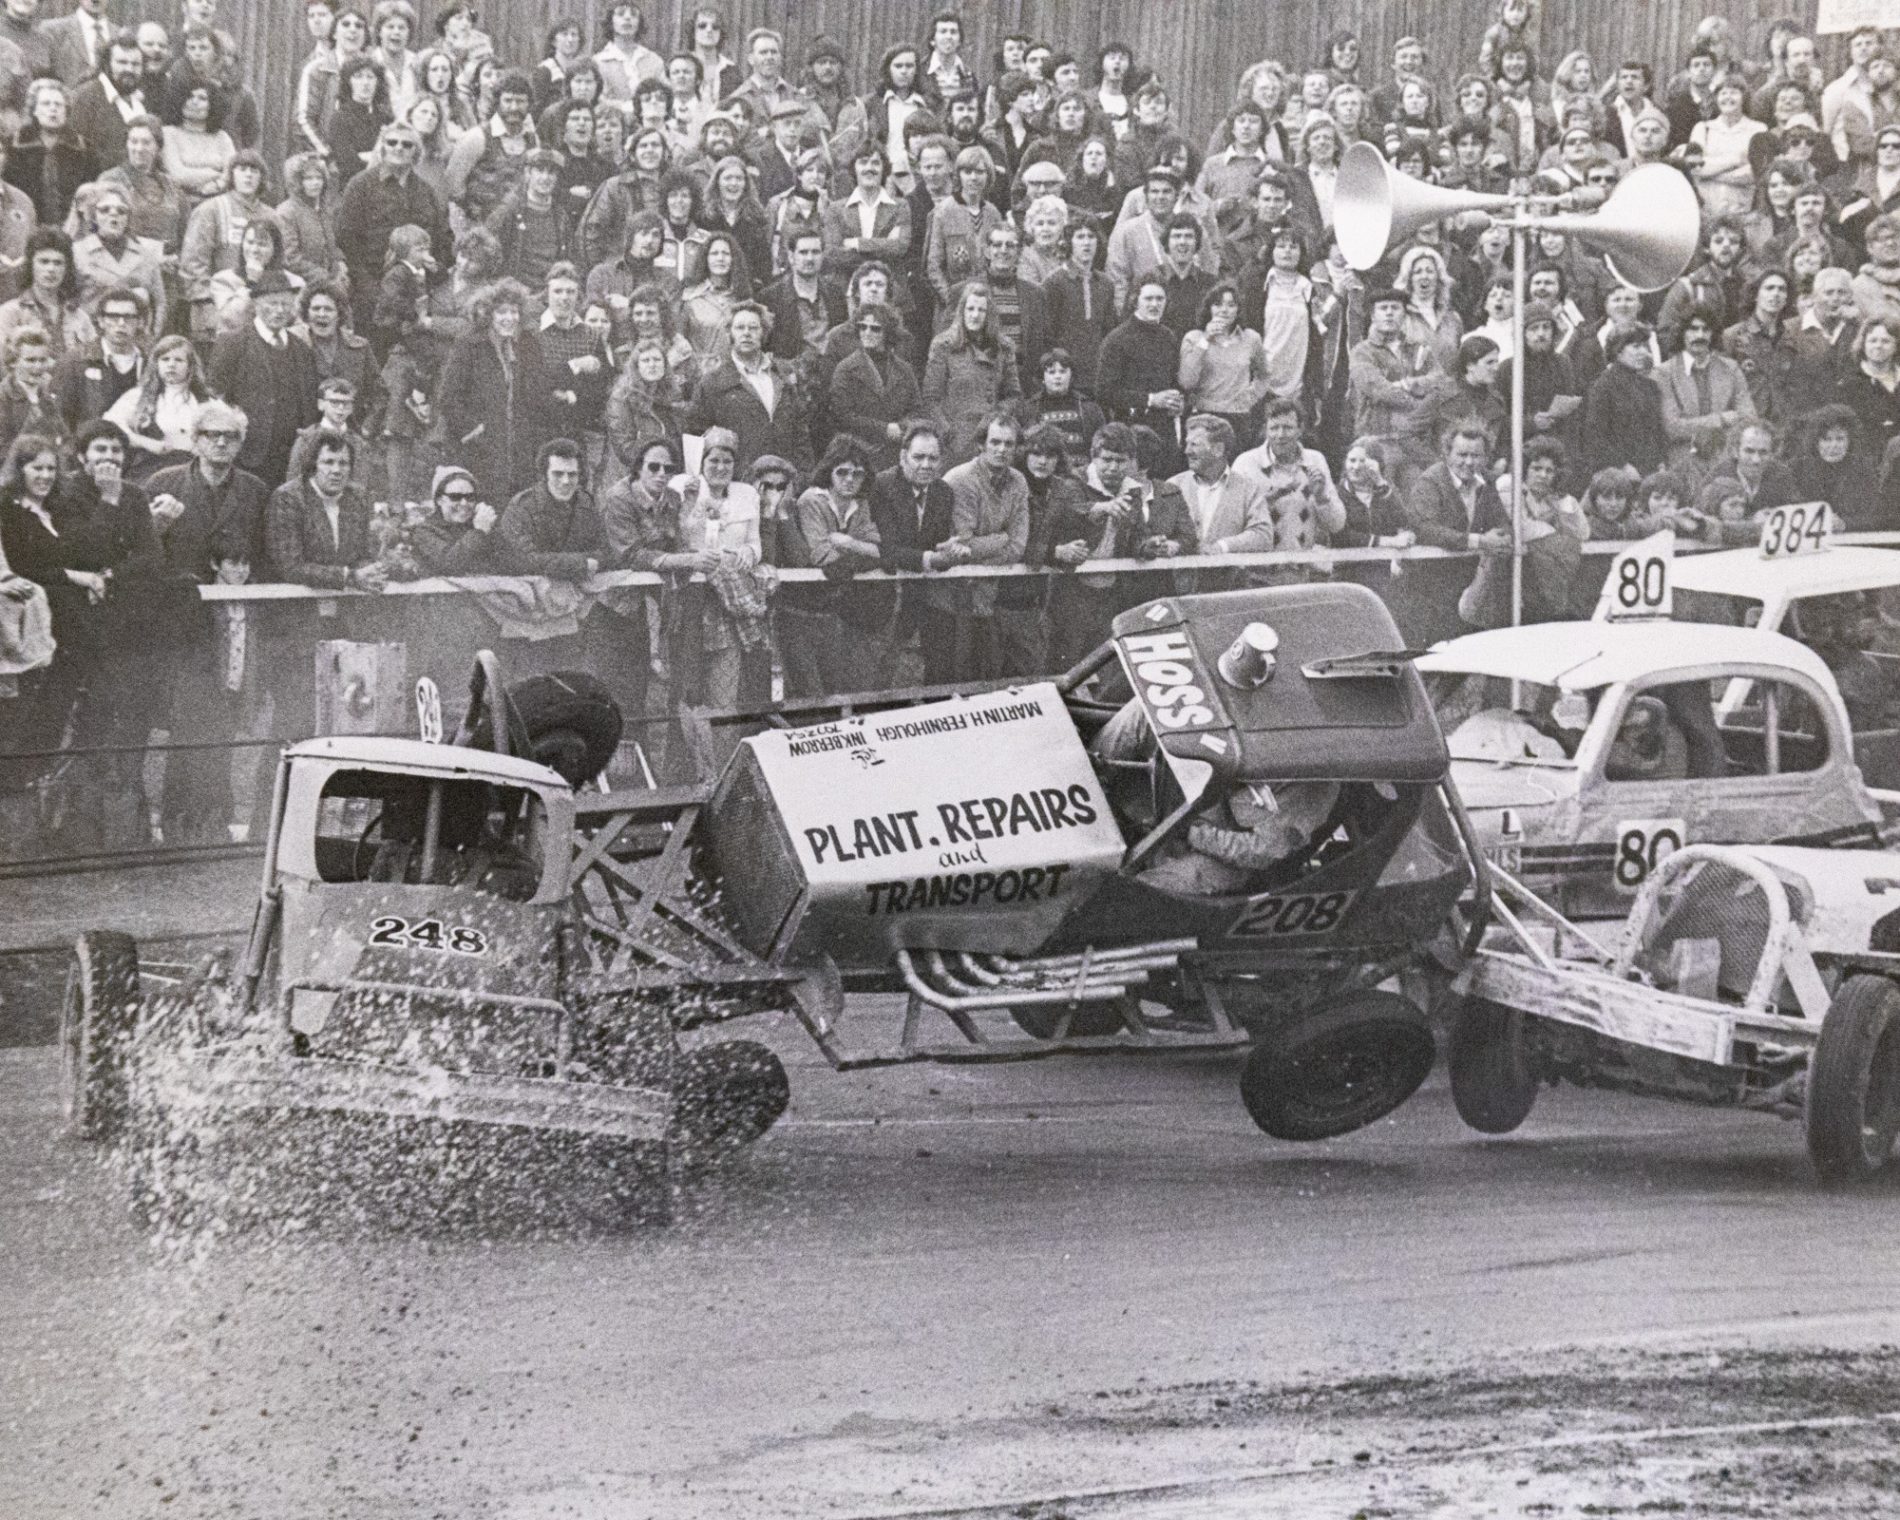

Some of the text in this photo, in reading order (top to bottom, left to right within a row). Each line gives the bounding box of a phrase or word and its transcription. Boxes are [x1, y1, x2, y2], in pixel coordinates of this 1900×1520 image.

[1765, 504, 1827, 556] 384
[1617, 556, 1666, 609] 80
[983, 701, 1043, 724] MARTIN
[788, 731, 868, 757] INKBERROW
[937, 784, 1097, 843] REPAIRS
[938, 843, 988, 868] and
[866, 863, 1070, 916] TRANSPORT
[1232, 892, 1347, 933] 208
[369, 916, 487, 955] 248
